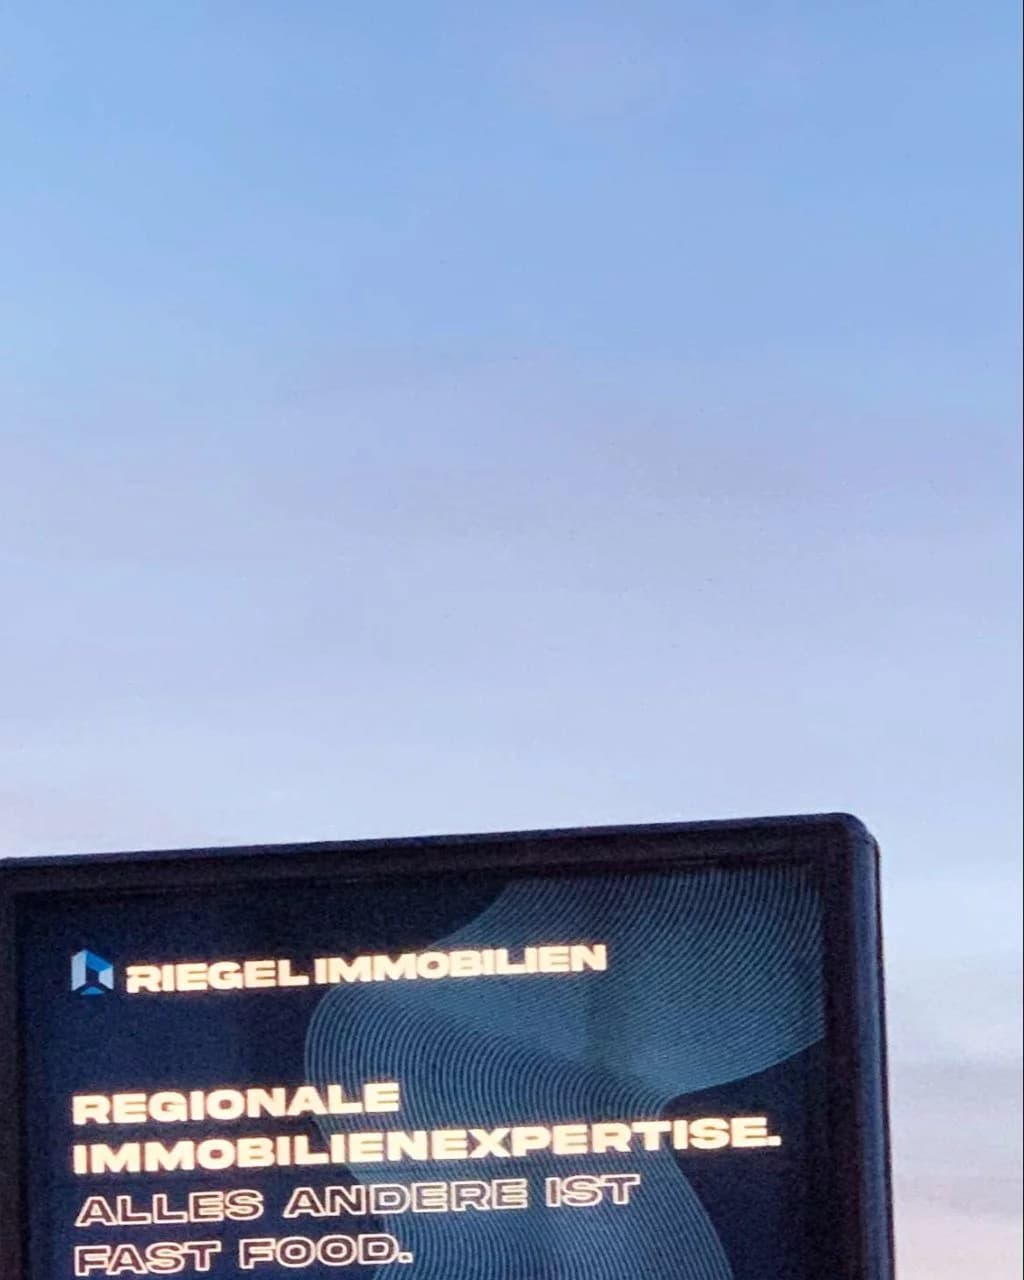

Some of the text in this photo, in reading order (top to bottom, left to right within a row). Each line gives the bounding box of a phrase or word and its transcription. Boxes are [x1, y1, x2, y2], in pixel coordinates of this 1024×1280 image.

[126, 944, 607, 993] RIEGEL IMMOBILIEN
[72, 1082, 401, 1125] REGIONALE
[72, 1117, 782, 1174] IMMOBILIENEXPERTISE.
[75, 1173, 641, 1227] ALLES ANDERE IST
[74, 1233, 414, 1276] FAST FOOD.
